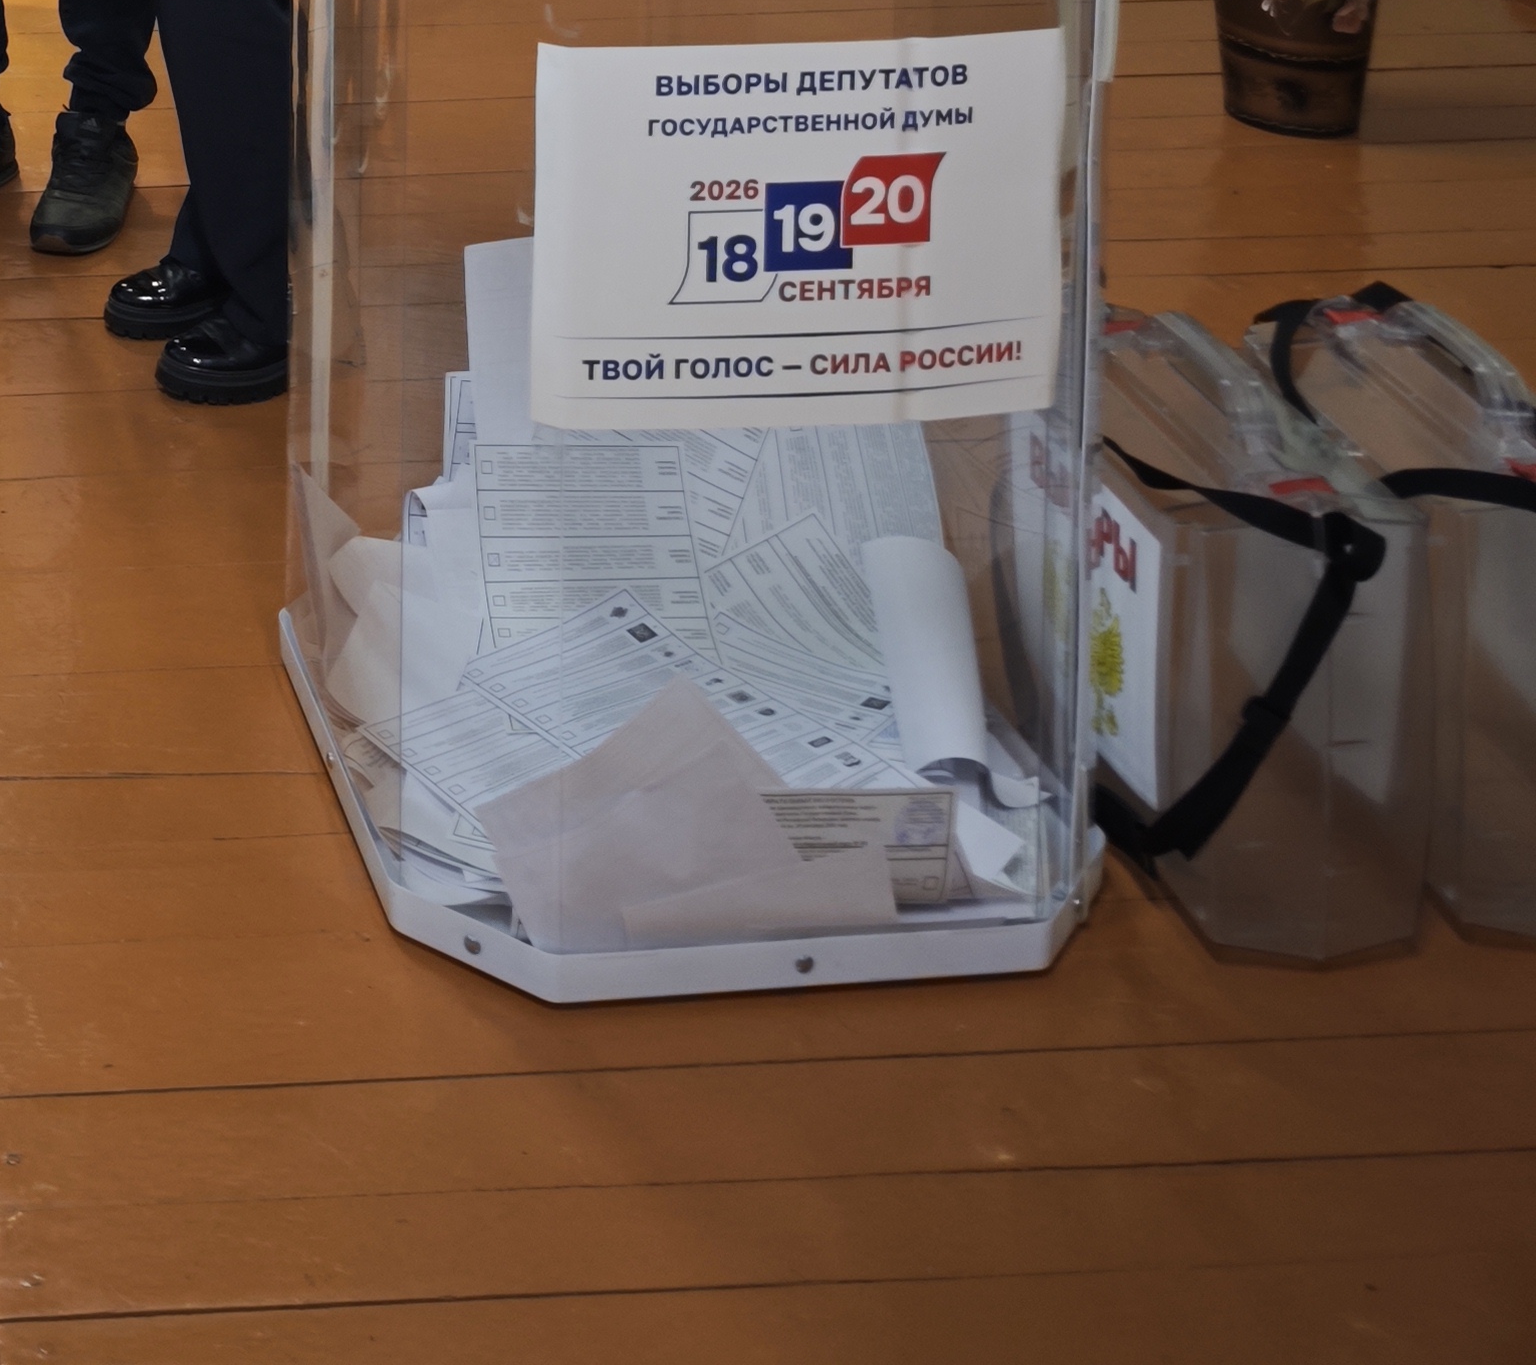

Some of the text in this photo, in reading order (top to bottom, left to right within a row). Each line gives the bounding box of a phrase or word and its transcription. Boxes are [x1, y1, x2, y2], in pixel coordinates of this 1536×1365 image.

[655, 64, 968, 96] ВЫБОРЫ ДЕПУТАТОВ
[648, 107, 974, 138] ГОСУДАРСТВЕННОЙ ДУМЫ
[689, 179, 759, 201] 2026
[697, 174, 925, 282] 18 19 20
[778, 275, 931, 302] СЕНТЯБРЯ
[582, 353, 665, 380] ТВОЙ
[674, 356, 774, 380] ГОЛОС
[809, 352, 892, 376] СИЛА
[899, 340, 1022, 373] РОССИИ!
